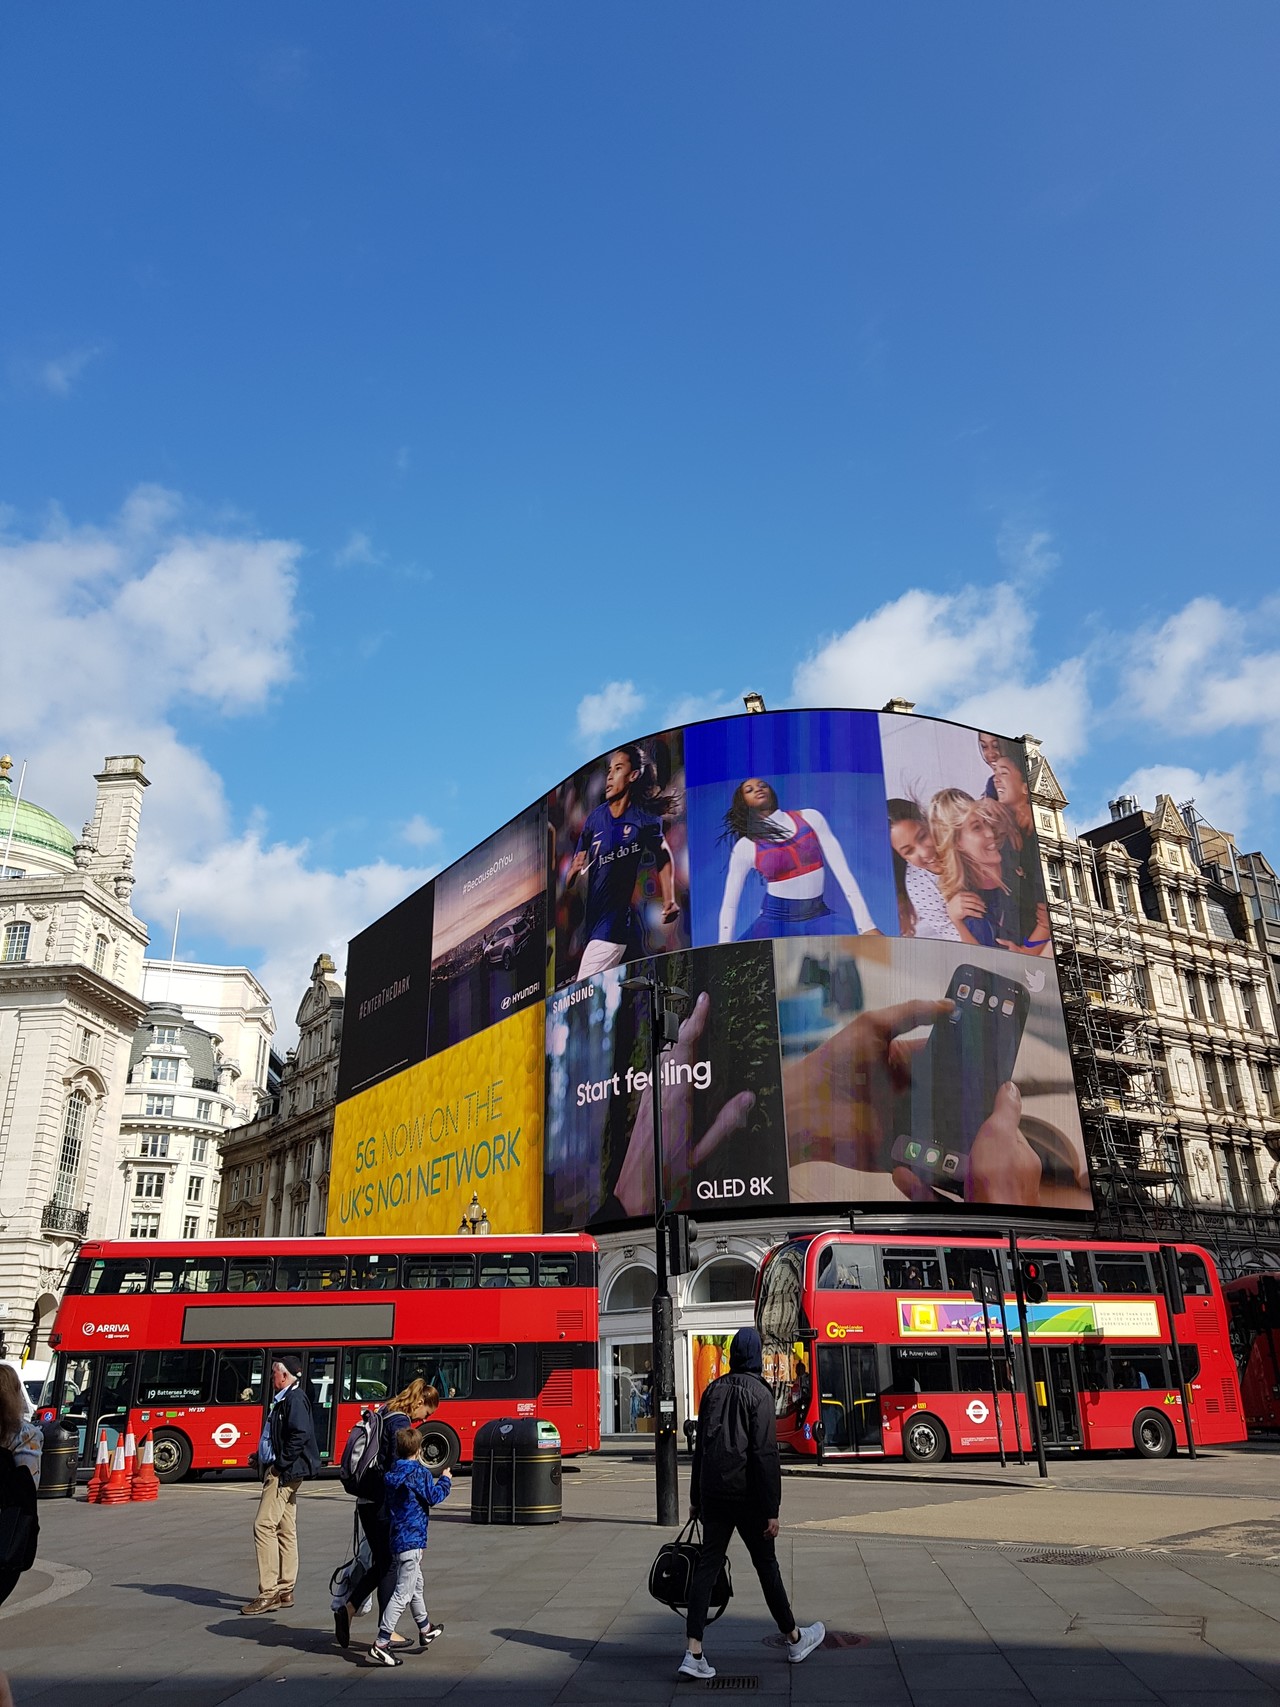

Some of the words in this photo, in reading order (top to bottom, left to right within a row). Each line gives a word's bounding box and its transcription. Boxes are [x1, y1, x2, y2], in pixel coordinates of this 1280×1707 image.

[592, 840, 601, 856] 7
[598, 851, 614, 868] Just
[616, 845, 629, 858] do
[631, 842, 640, 853] it.
[463, 853, 513, 896] #BecauseOfYou
[512, 982, 540, 1004] HYUNDAI
[553, 984, 594, 1014] SAMSUNG
[577, 1072, 620, 1106] Start
[355, 1137, 377, 1173] 5G.
[382, 1114, 425, 1164] NOW
[430, 1101, 459, 1142] ON
[464, 1080, 503, 1130] THE
[340, 1182, 374, 1224] UK'S
[377, 1168, 412, 1213] NO.1
[416, 1127, 521, 1200] NETWORK
[696, 1178, 745, 1200] QLED
[749, 1176, 774, 1196] 8K
[96, 1324, 130, 1333] ARRIVA
[826, 1321, 846, 1338] Go
[900, 1349, 907, 1358] 14
[147, 1389, 156, 1399] 19
[183, 1388, 200, 1396] Bridge
